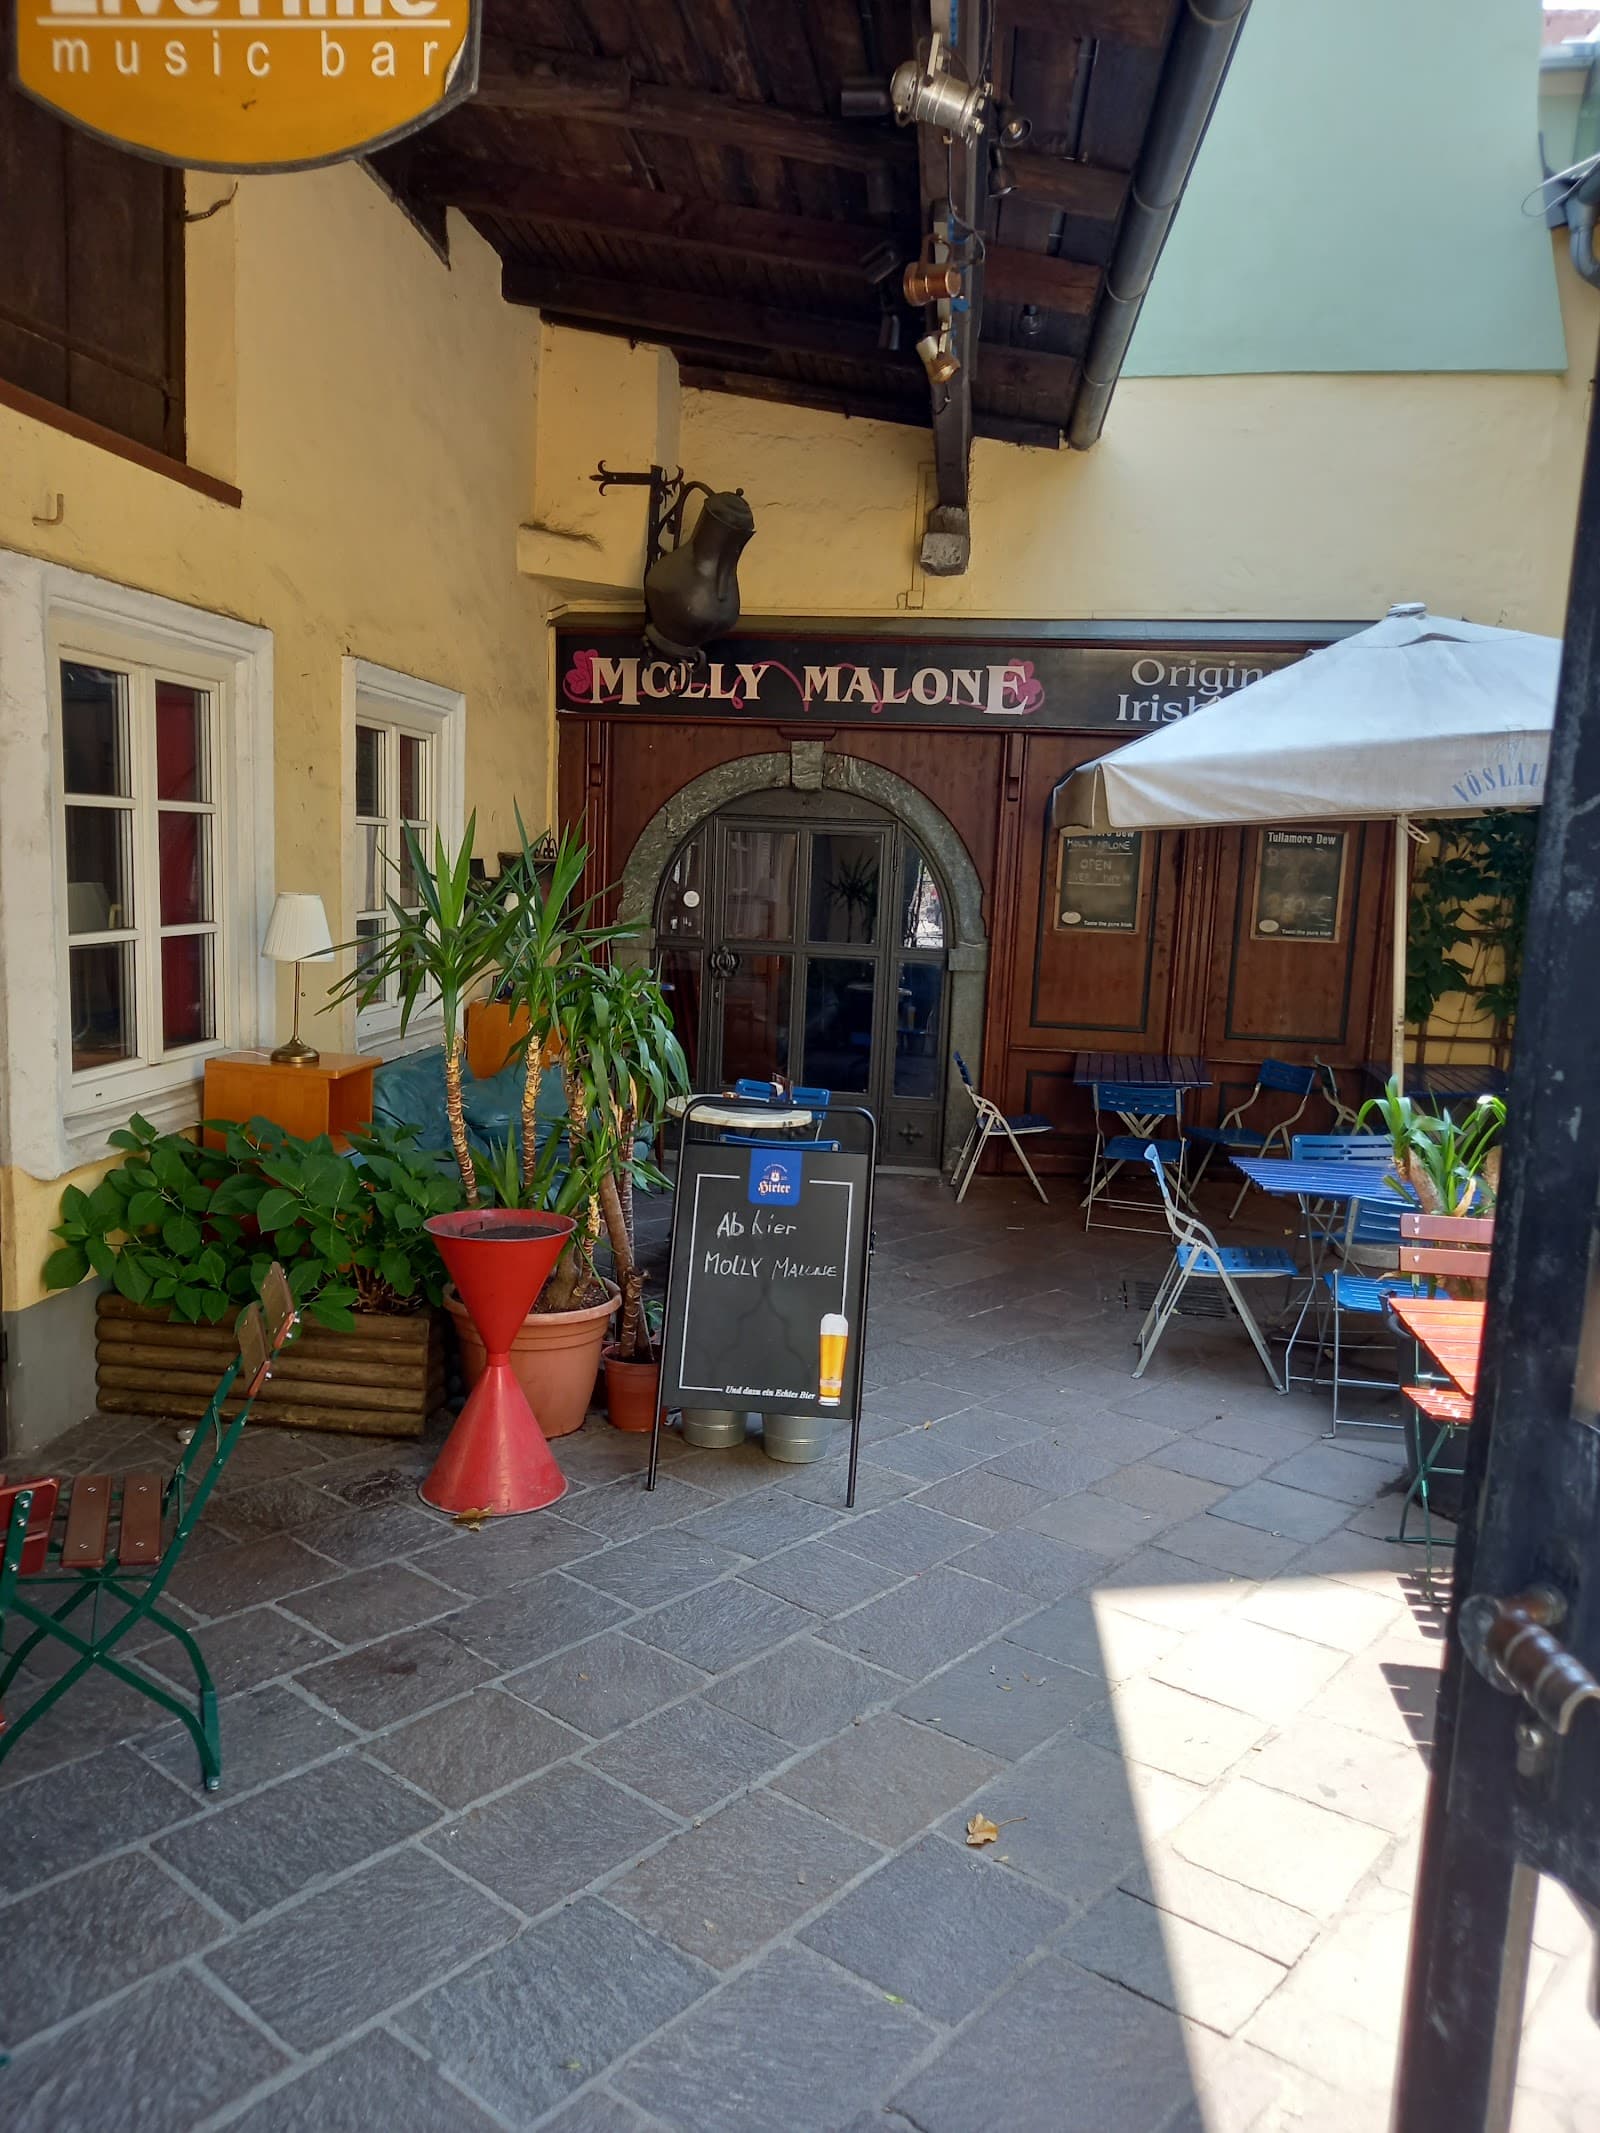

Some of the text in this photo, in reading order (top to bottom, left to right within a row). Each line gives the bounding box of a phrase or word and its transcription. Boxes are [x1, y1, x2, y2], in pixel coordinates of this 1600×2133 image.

[52, 29, 439, 77] music bar
[588, 656, 1029, 715] MOLLY MALONE
[1131, 658, 1275, 695] Origin
[1268, 832, 1337, 845] Tullamore Dew
[758, 1180, 791, 1196] Hirter
[716, 1209, 797, 1238] Ab hier
[704, 1250, 764, 1278] MOLLY
[799, 1390, 816, 1400] Bier
